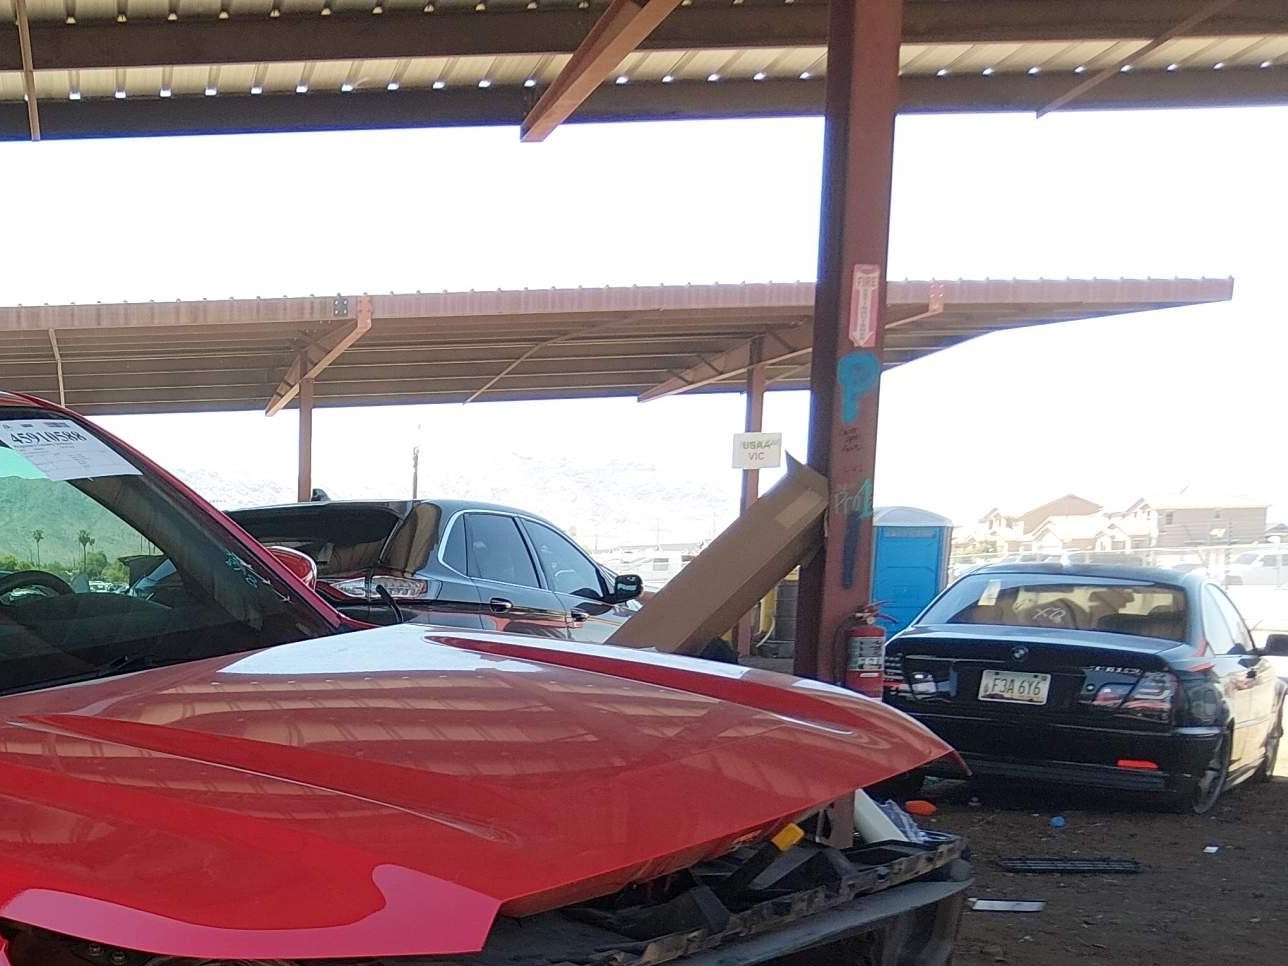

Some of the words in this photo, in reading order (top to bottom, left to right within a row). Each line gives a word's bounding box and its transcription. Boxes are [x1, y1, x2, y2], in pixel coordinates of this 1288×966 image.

[837, 352, 881, 424] P
[10, 431, 87, 445] 45910588
[748, 451, 765, 461] VIC
[992, 677, 1015, 693] F3A
[1017, 680, 1041, 696] 6Y6
